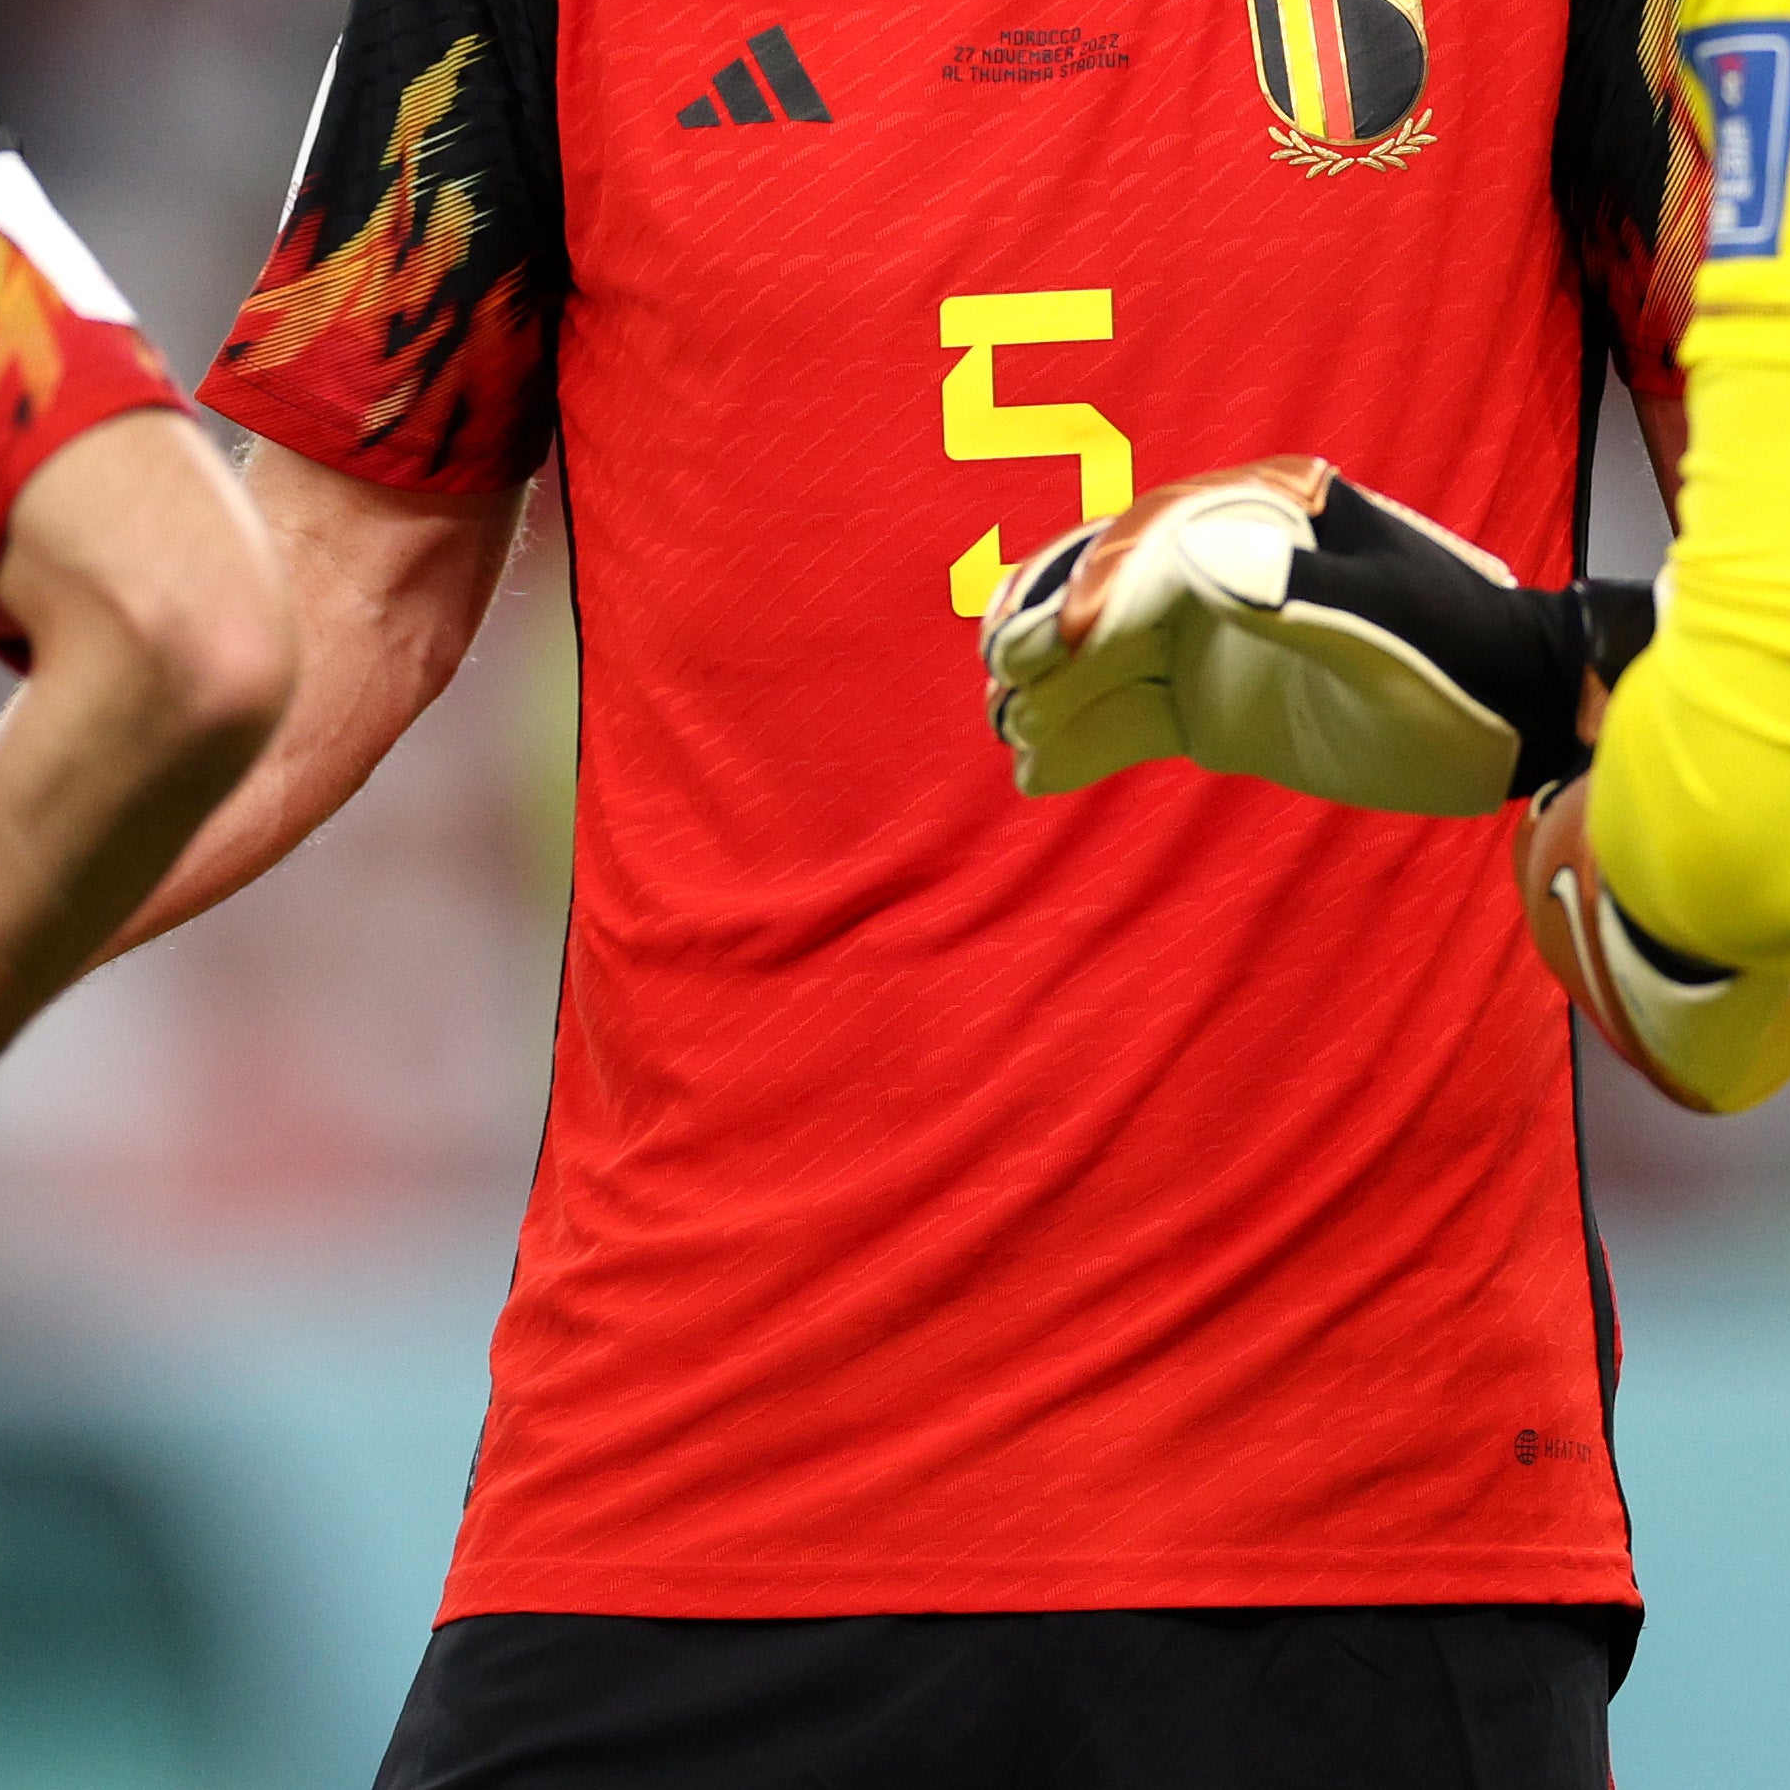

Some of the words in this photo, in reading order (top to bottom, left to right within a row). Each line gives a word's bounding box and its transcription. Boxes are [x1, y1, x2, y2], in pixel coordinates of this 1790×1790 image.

[954, 46, 975, 62] 27
[982, 47, 1074, 64] NOVEMBER
[1079, 33, 1120, 56] 2022
[1000, 27, 1081, 46] MOROCCO
[942, 66, 963, 82] AL
[970, 66, 1053, 83] THUMAMA
[1061, 53, 1129, 78] STADIUM
[940, 289, 1134, 618] 5
